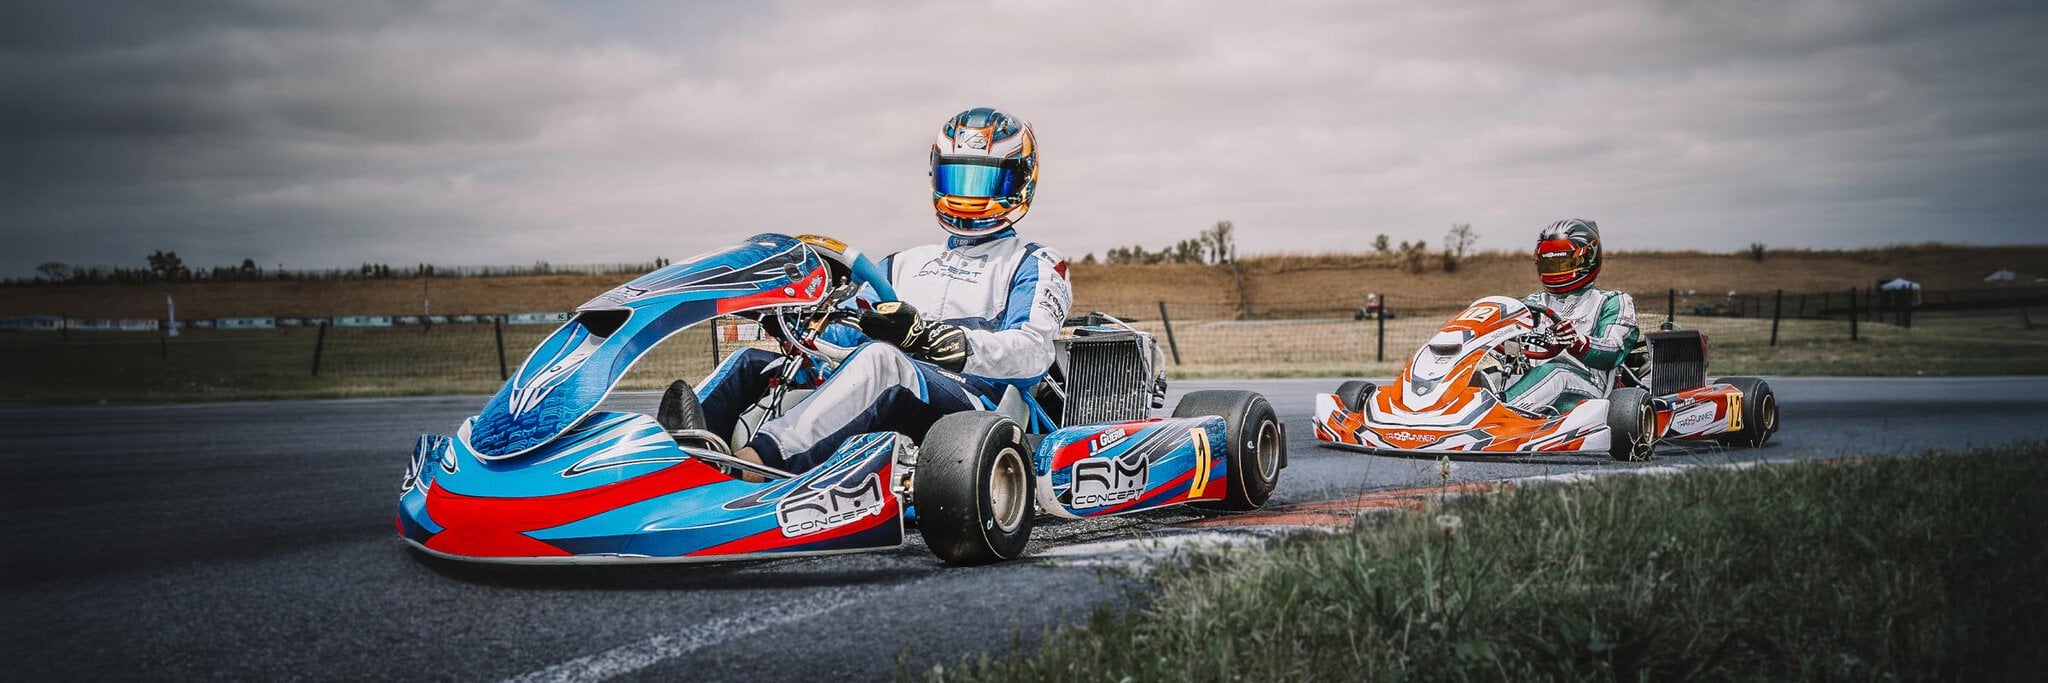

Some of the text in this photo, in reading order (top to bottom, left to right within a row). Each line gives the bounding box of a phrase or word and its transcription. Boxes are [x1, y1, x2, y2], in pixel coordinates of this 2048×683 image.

[1465, 307, 1493, 319] 12
[1729, 395, 1740, 428] 12
[1075, 460, 1147, 493] RM
[1075, 489, 1144, 505] CONCEPT
[786, 504, 880, 534] CONCEPT
